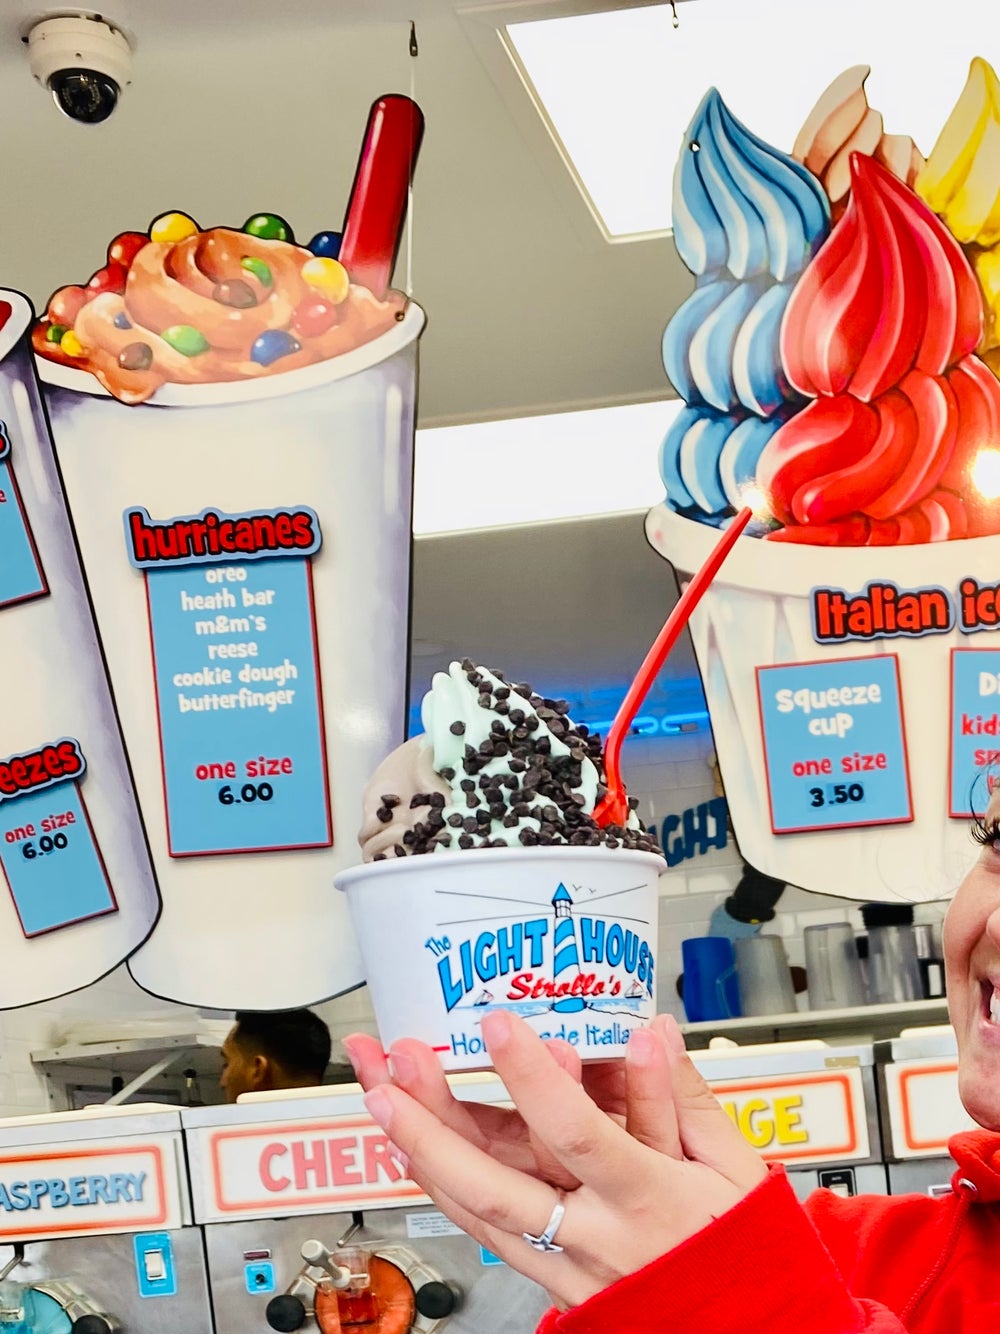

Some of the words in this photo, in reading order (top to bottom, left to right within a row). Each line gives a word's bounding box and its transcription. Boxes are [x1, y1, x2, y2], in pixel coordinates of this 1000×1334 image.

[129, 512, 314, 561] hurricanes
[205, 566, 247, 583] oreo
[180, 588, 236, 611] heath
[241, 588, 275, 607] bar
[814, 583, 950, 638] Italian
[195, 614, 267, 635] m&m's
[208, 642, 258, 660] reese
[173, 667, 232, 687] cookie
[238, 659, 298, 686] dough
[178, 687, 296, 713] butterfinger
[775, 683, 882, 714] Squeeze
[808, 712, 853, 738] cup
[195, 762, 236, 780] one
[245, 755, 293, 778] size
[792, 758, 831, 777] one
[841, 752, 887, 773] size
[218, 782, 274, 805] 6.00
[809, 783, 864, 807] 3.50
[5, 824, 36, 843] one
[41, 811, 76, 832] size
[646, 797, 729, 867] GHT
[22, 832, 68, 859] 6.00
[424, 934, 452, 957] The
[437, 918, 548, 1014] LIGHT
[507, 972, 622, 1000] Strollo's
[586, 1022, 632, 1046] Italia
[259, 1135, 410, 1191] CHER
